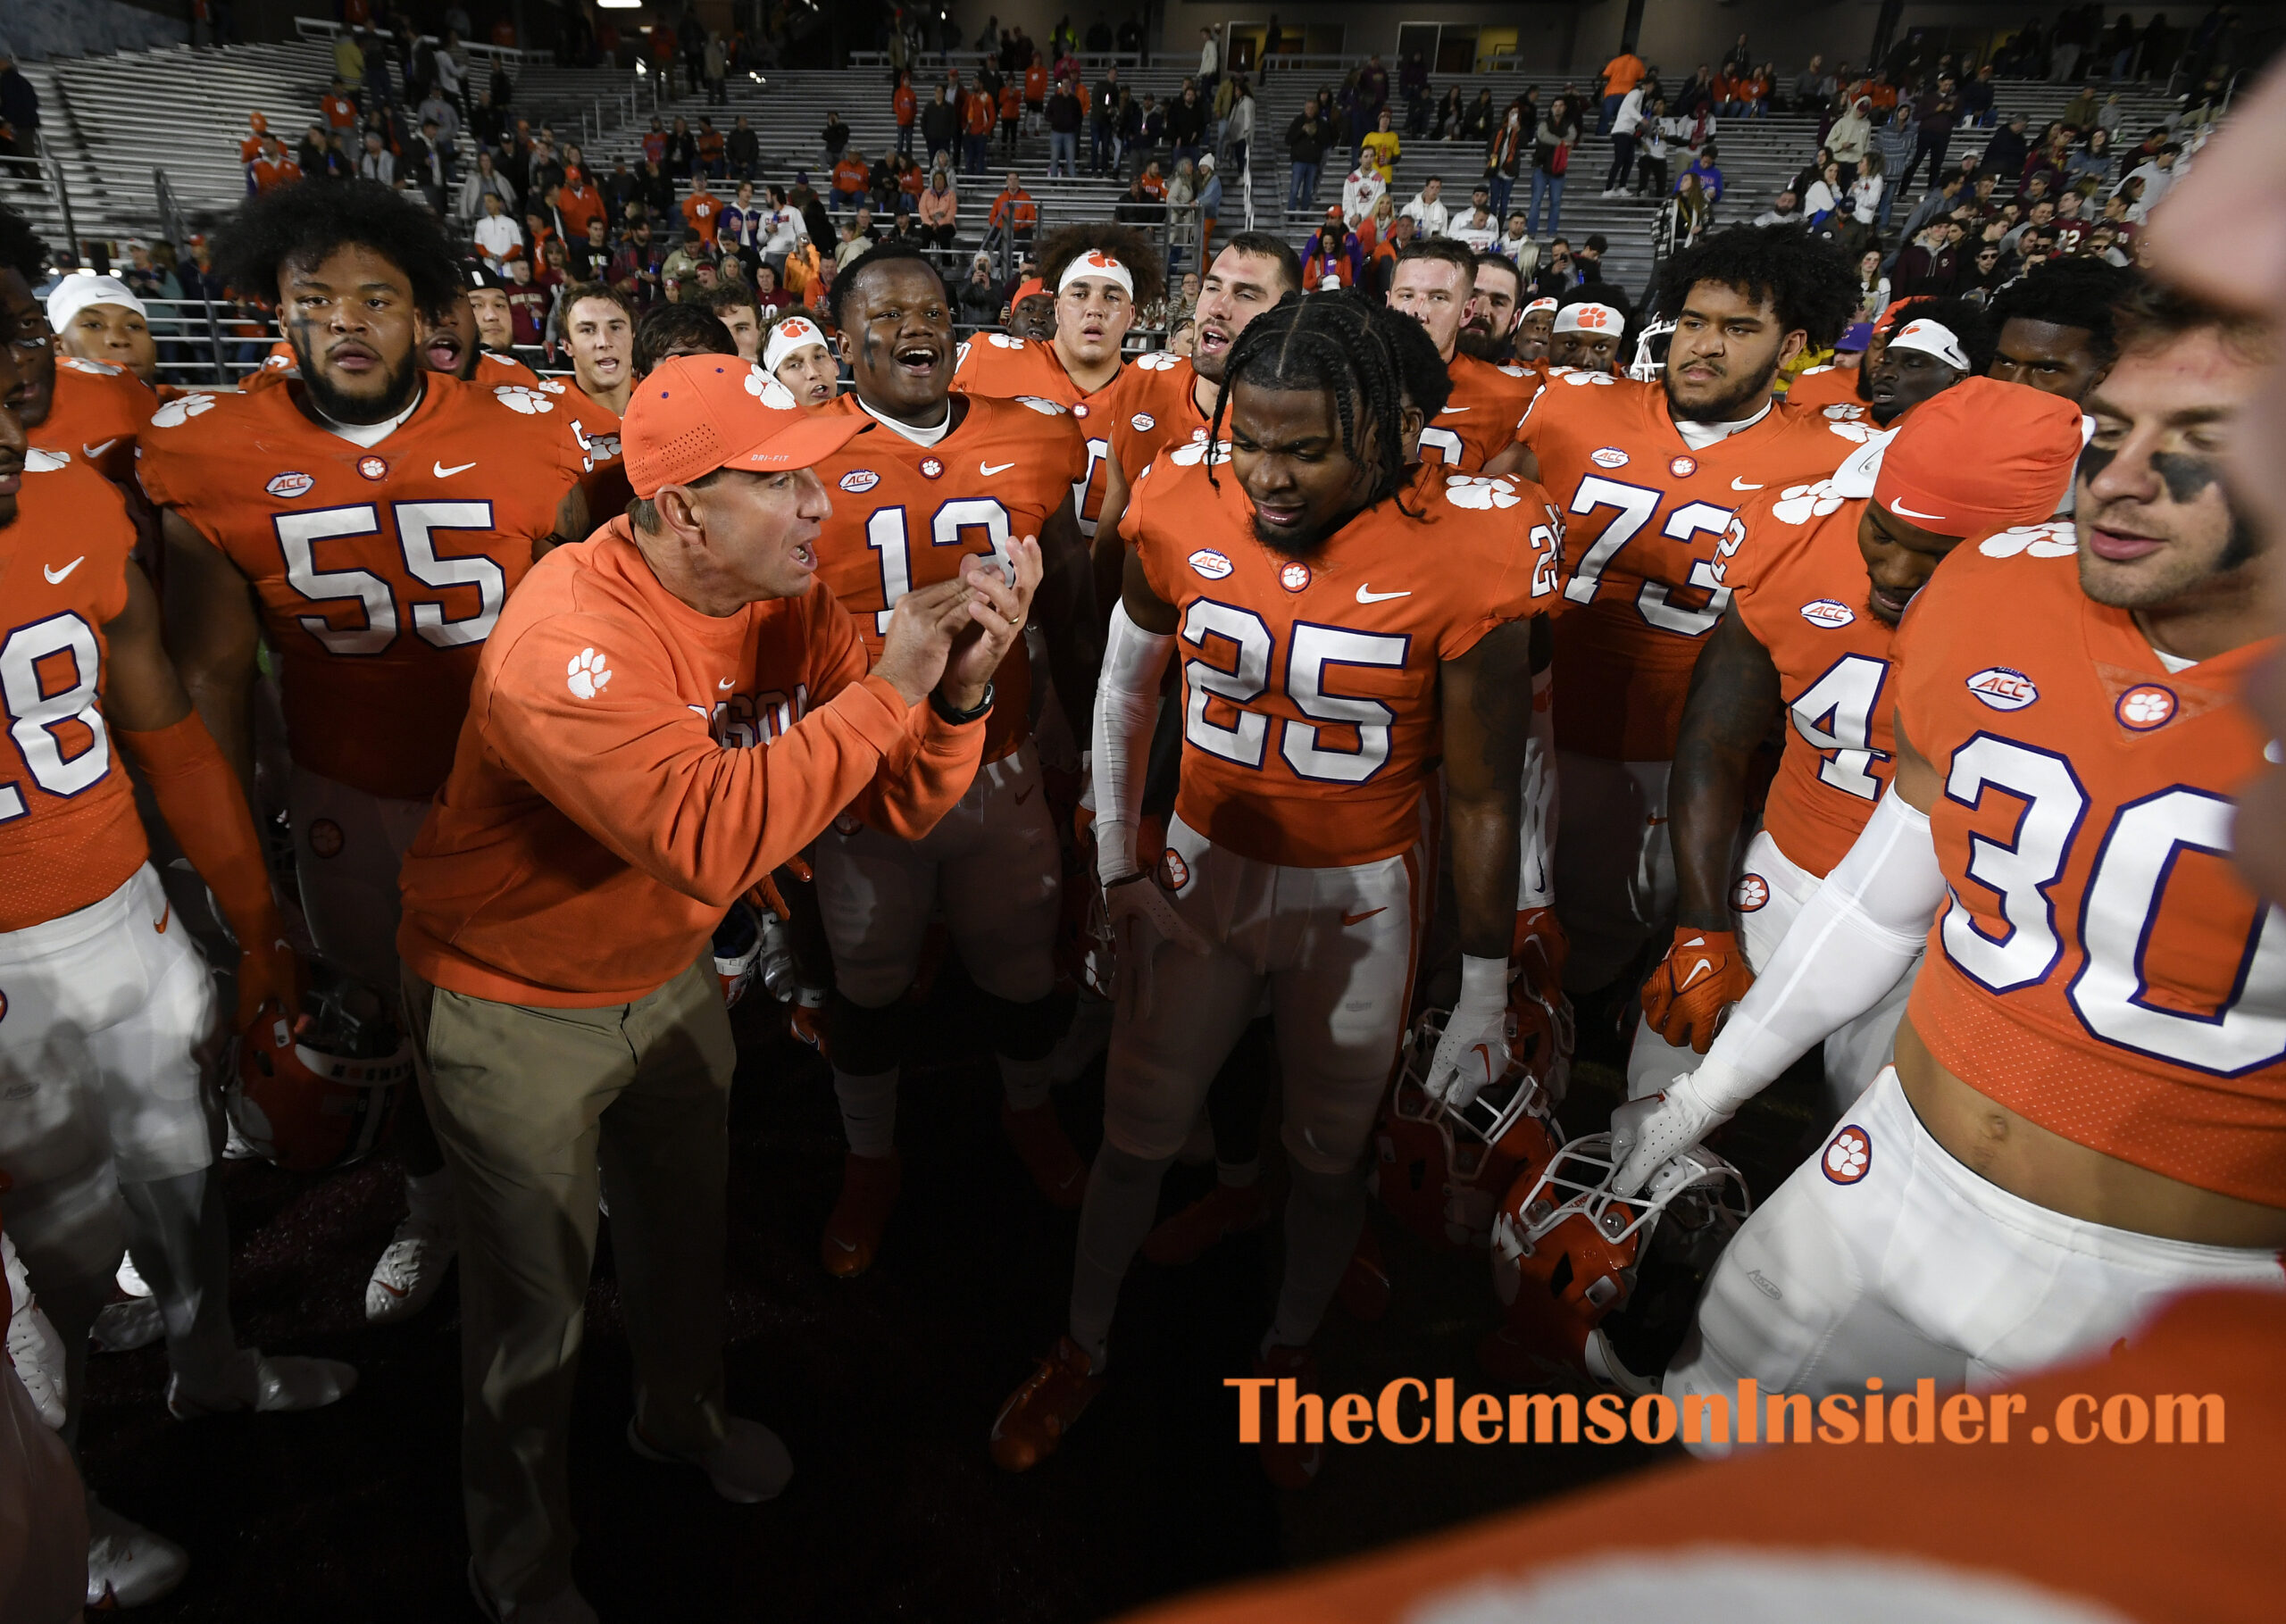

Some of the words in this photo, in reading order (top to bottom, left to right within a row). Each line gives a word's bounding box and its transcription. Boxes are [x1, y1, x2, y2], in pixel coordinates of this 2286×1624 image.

[752, 454, 789, 462] DRI-FIT
[1598, 451, 1625, 462] ACC
[271, 474, 308, 490] ACC
[844, 470, 873, 486] ACC
[1193, 554, 1227, 571] ACC
[1568, 472, 1738, 637] 73
[271, 498, 506, 658] 55
[1806, 605, 1848, 620] ACC
[1181, 595, 1413, 787] 25
[1976, 675, 2032, 698] ACC
[1944, 729, 2286, 1079] 30
